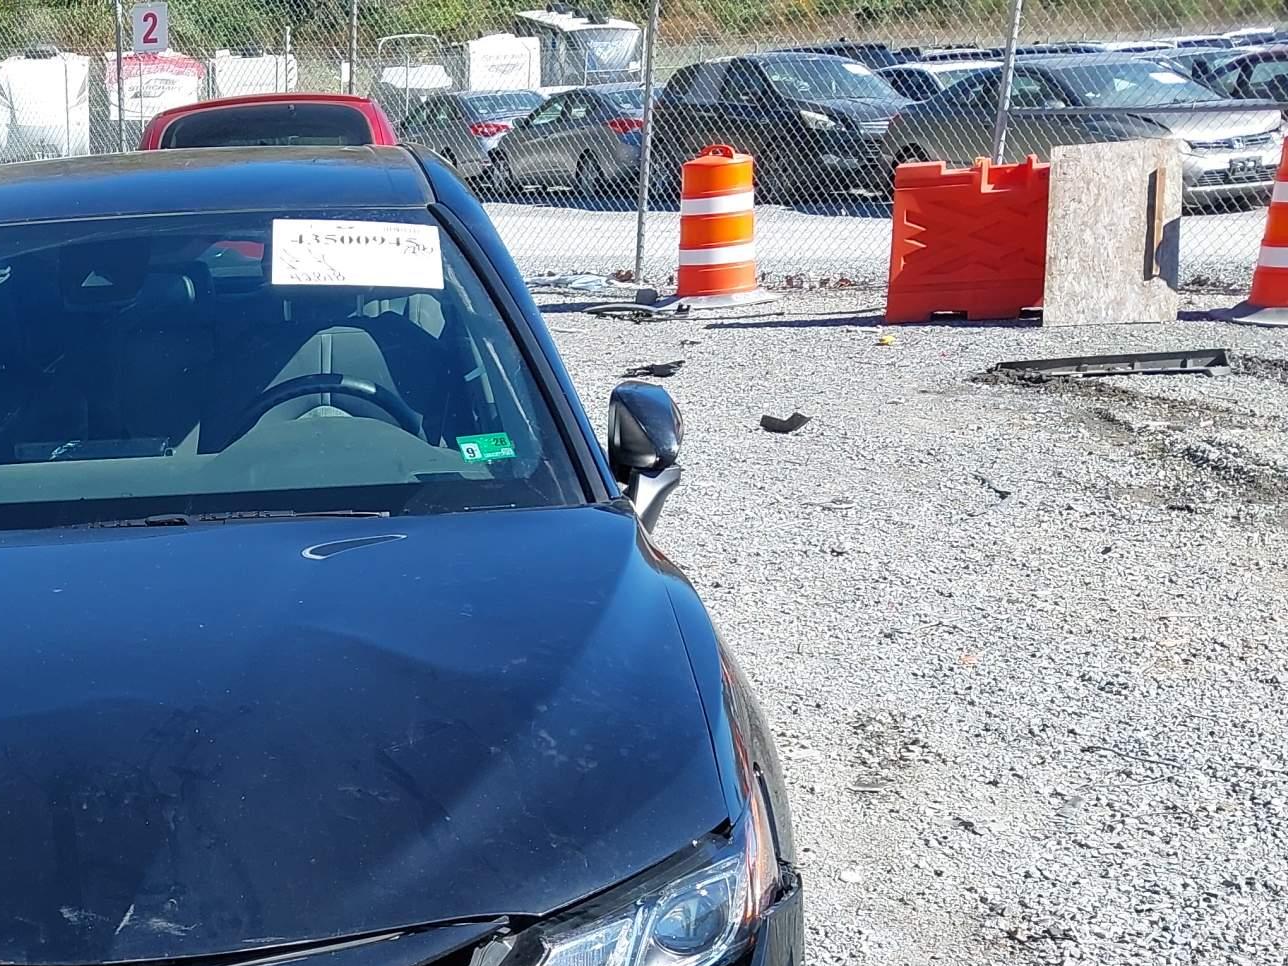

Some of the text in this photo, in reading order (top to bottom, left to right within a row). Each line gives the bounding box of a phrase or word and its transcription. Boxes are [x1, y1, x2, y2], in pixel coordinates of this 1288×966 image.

[143, 12, 158, 44] 2
[290, 233, 420, 248] 43500945
[466, 447, 476, 458] 9
